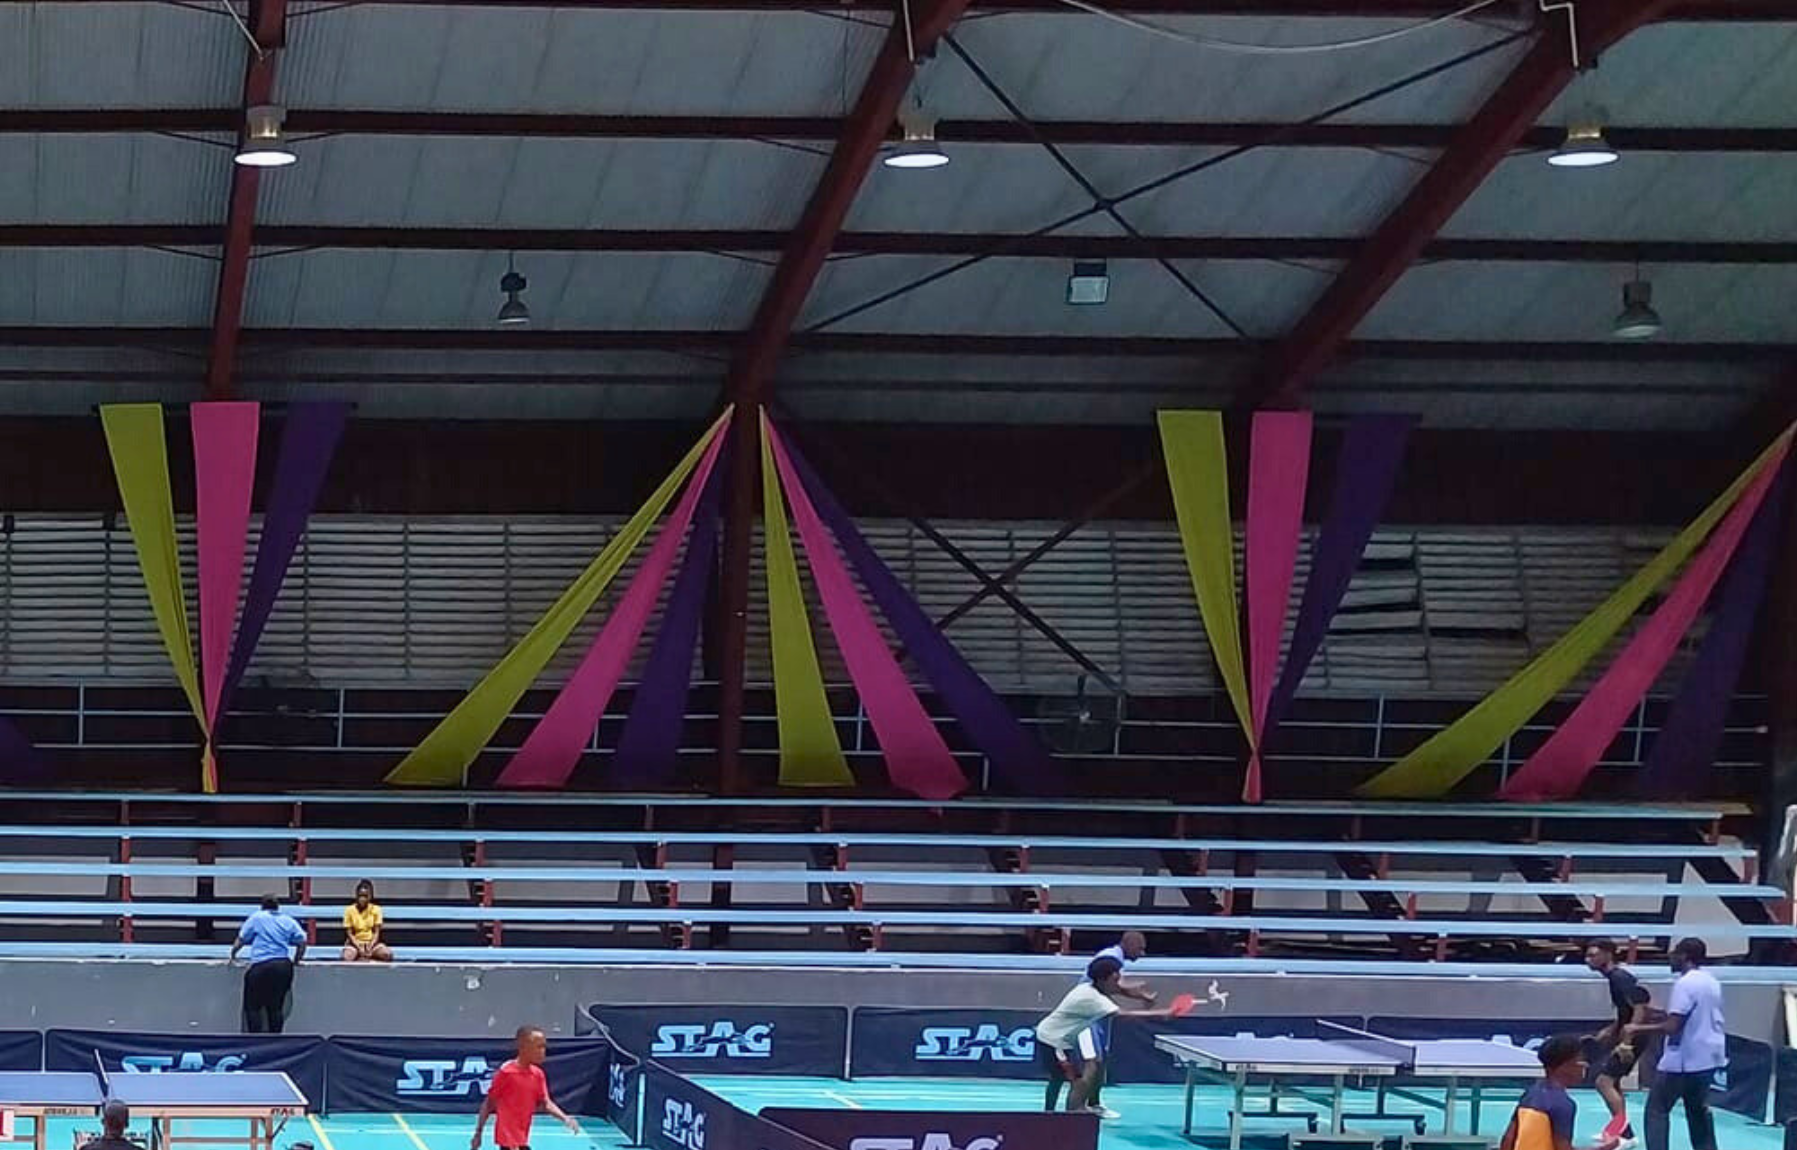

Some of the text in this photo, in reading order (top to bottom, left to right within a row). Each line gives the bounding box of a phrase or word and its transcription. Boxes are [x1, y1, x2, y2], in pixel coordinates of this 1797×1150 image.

[652, 1021, 771, 1058] STAG
[916, 1025, 1035, 1060] STAG
[396, 1056, 492, 1095] STA
